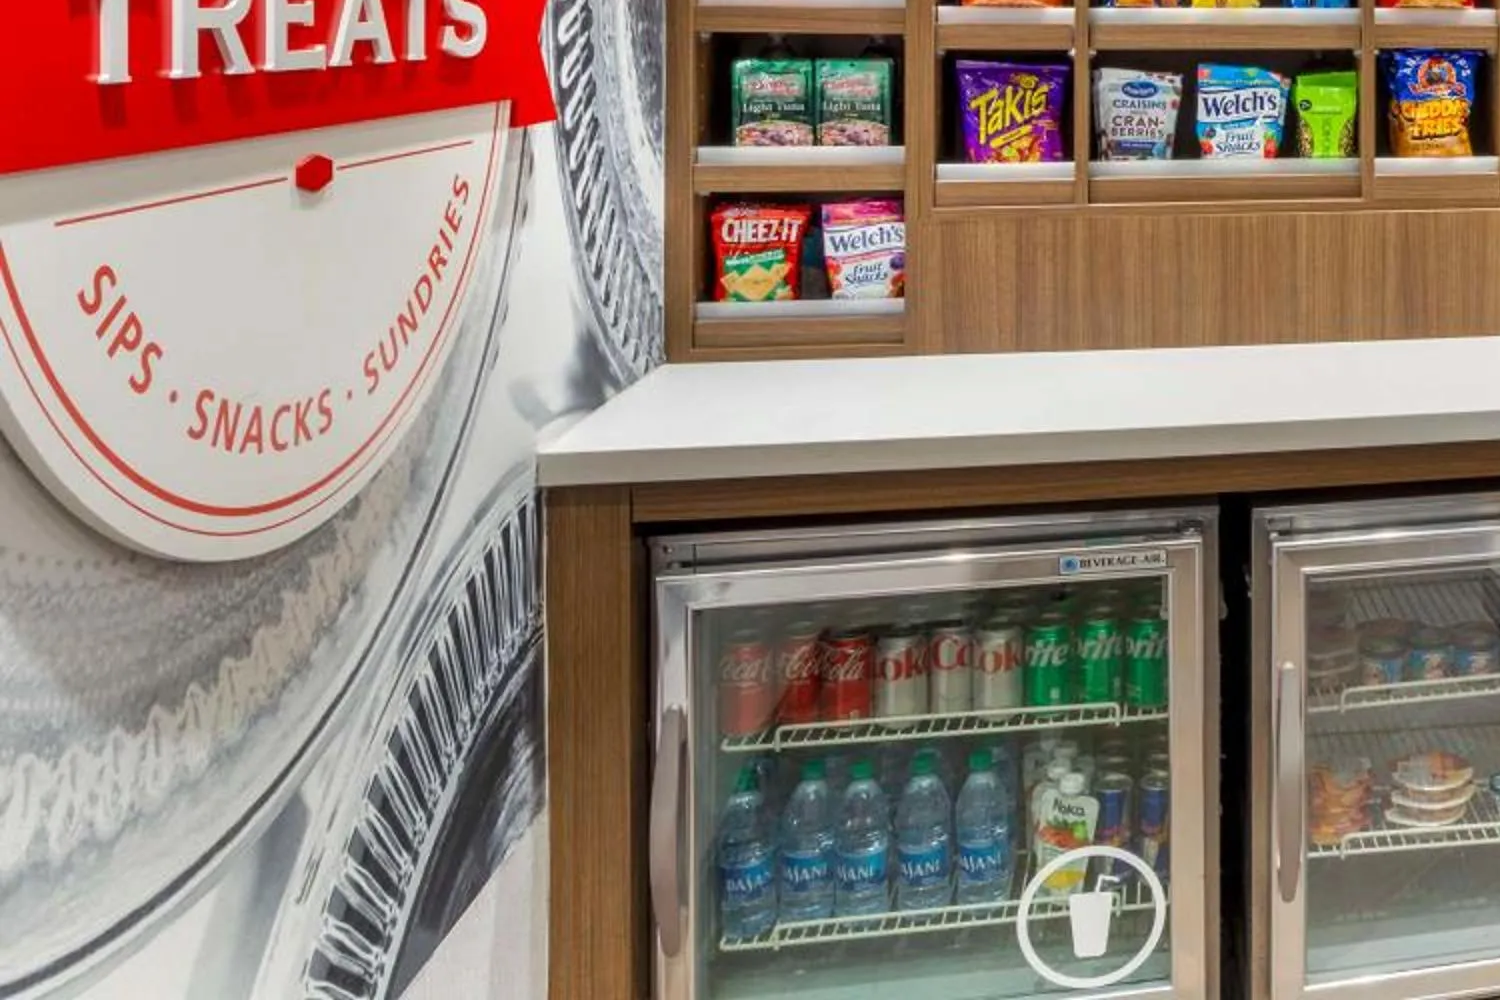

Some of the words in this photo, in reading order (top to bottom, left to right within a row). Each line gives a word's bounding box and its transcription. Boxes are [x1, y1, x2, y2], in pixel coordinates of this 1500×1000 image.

[968, 82, 1050, 146] Takis
[1201, 90, 1278, 118] Welch's
[1111, 114, 1165, 128] CRAN-
[829, 224, 905, 253] Welch's
[76, 264, 164, 397] SIPS
[186, 387, 335, 456] SNACKS
[362, 172, 471, 397] SUNDRIES
